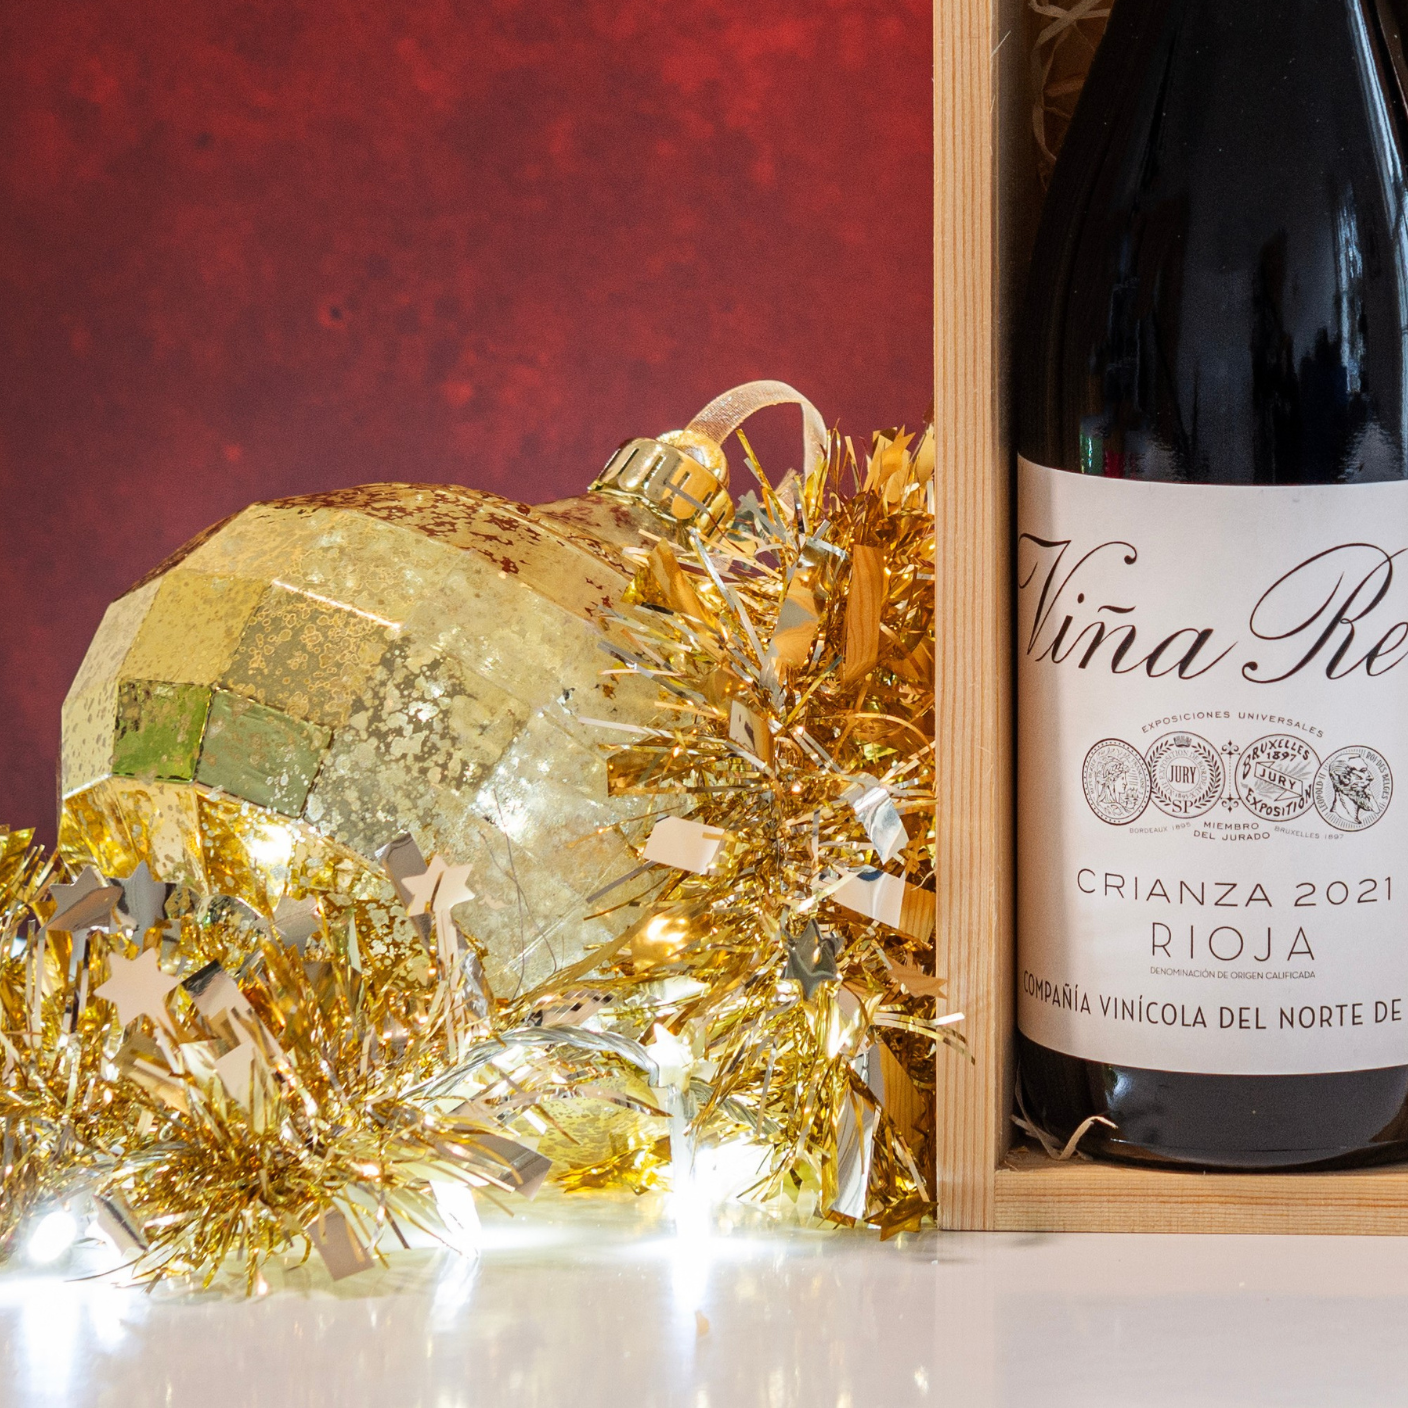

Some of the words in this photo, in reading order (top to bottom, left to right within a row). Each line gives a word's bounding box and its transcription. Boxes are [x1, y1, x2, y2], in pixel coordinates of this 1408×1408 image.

[1018, 533, 1238, 680] Viña
[1141, 711, 1231, 734] EXPOSICIONES
[1238, 711, 1324, 739] UNIVERSALES
[1242, 738, 1310, 780] BRUXELLES
[1266, 750, 1297, 763] 1897
[1169, 765, 1197, 784] JURY
[1259, 767, 1297, 790] JURY
[1172, 800, 1194, 814] SP
[1246, 783, 1313, 817] EXPOSITION
[1129, 826, 1168, 834] BORDEAUX
[1172, 822, 1191, 831] 1895
[1193, 830, 1216, 840] DEL
[1222, 832, 1271, 841] JURADO
[1203, 821, 1260, 831] MIEMBRO
[1274, 825, 1320, 840] BRUXELLES
[1077, 868, 1273, 908] CRIANZA
[1294, 876, 1392, 908] 2021
[1151, 922, 1315, 962] RIOJA
[1150, 966, 1216, 979] DENOMINACIÓN
[1217, 970, 1229, 979] DE
[1230, 971, 1264, 980] ORIGEN
[1265, 970, 1316, 980] CALIFICADA
[1022, 969, 1091, 1014] COMPAÑÍA
[1100, 994, 1207, 1028] VINÍCOLA
[1219, 1006, 1267, 1029] DEL
[1279, 1003, 1363, 1029] NORTE
[1374, 998, 1402, 1024] DE
